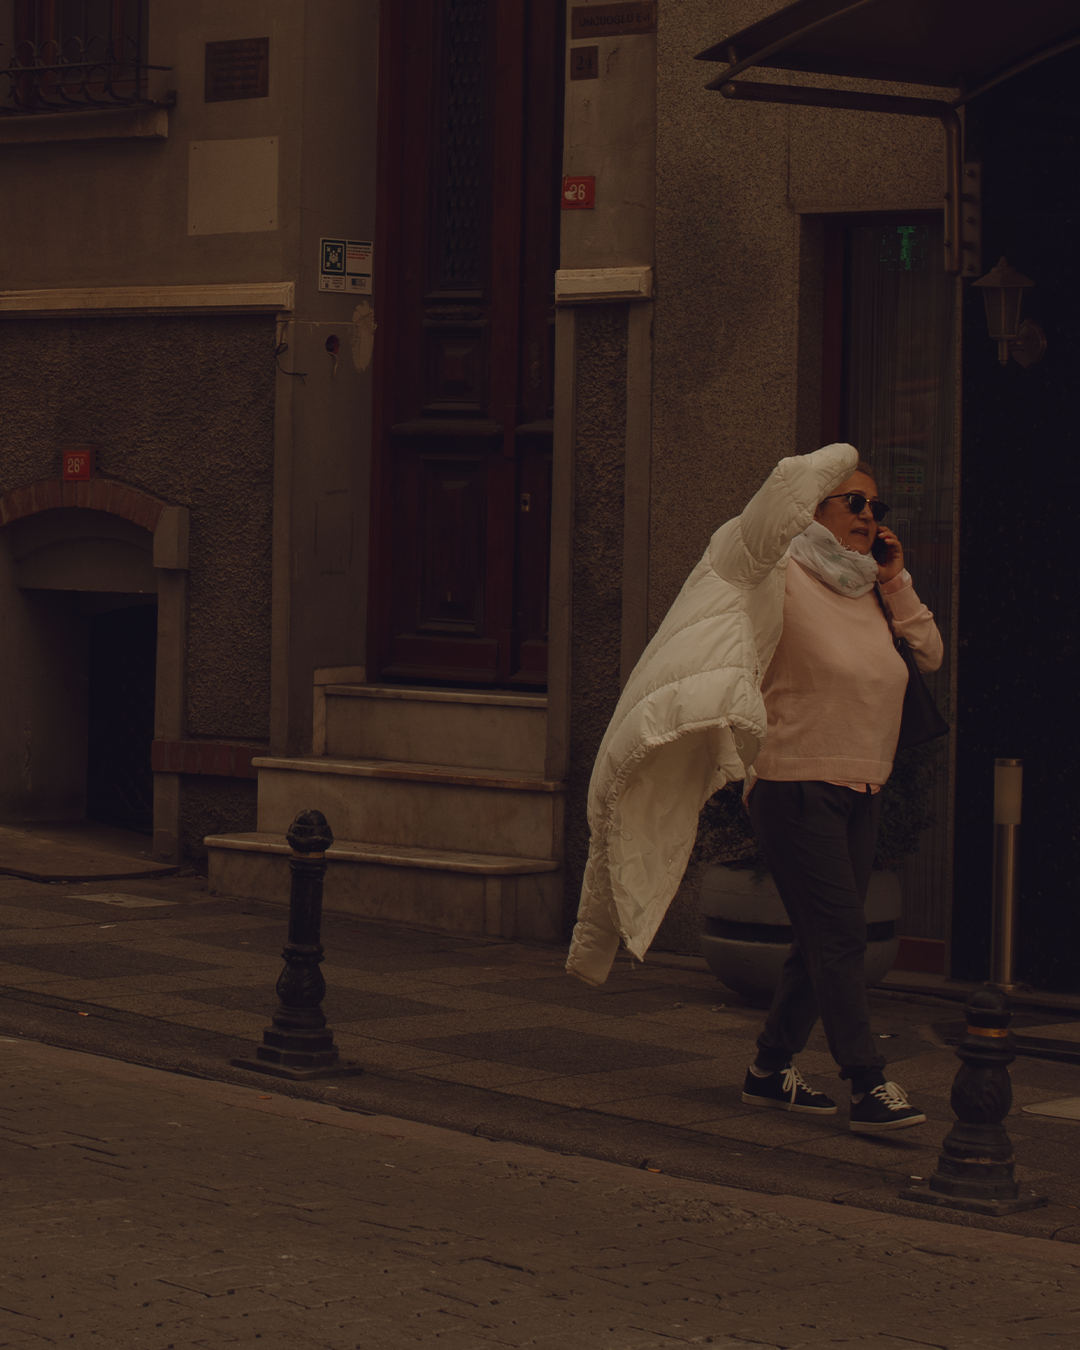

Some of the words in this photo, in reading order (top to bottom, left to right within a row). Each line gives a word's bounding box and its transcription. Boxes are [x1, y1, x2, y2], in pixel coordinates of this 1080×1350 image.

[636, 12, 651, 22] Evi
[575, 52, 593, 71] 24
[569, 183, 586, 200] 26
